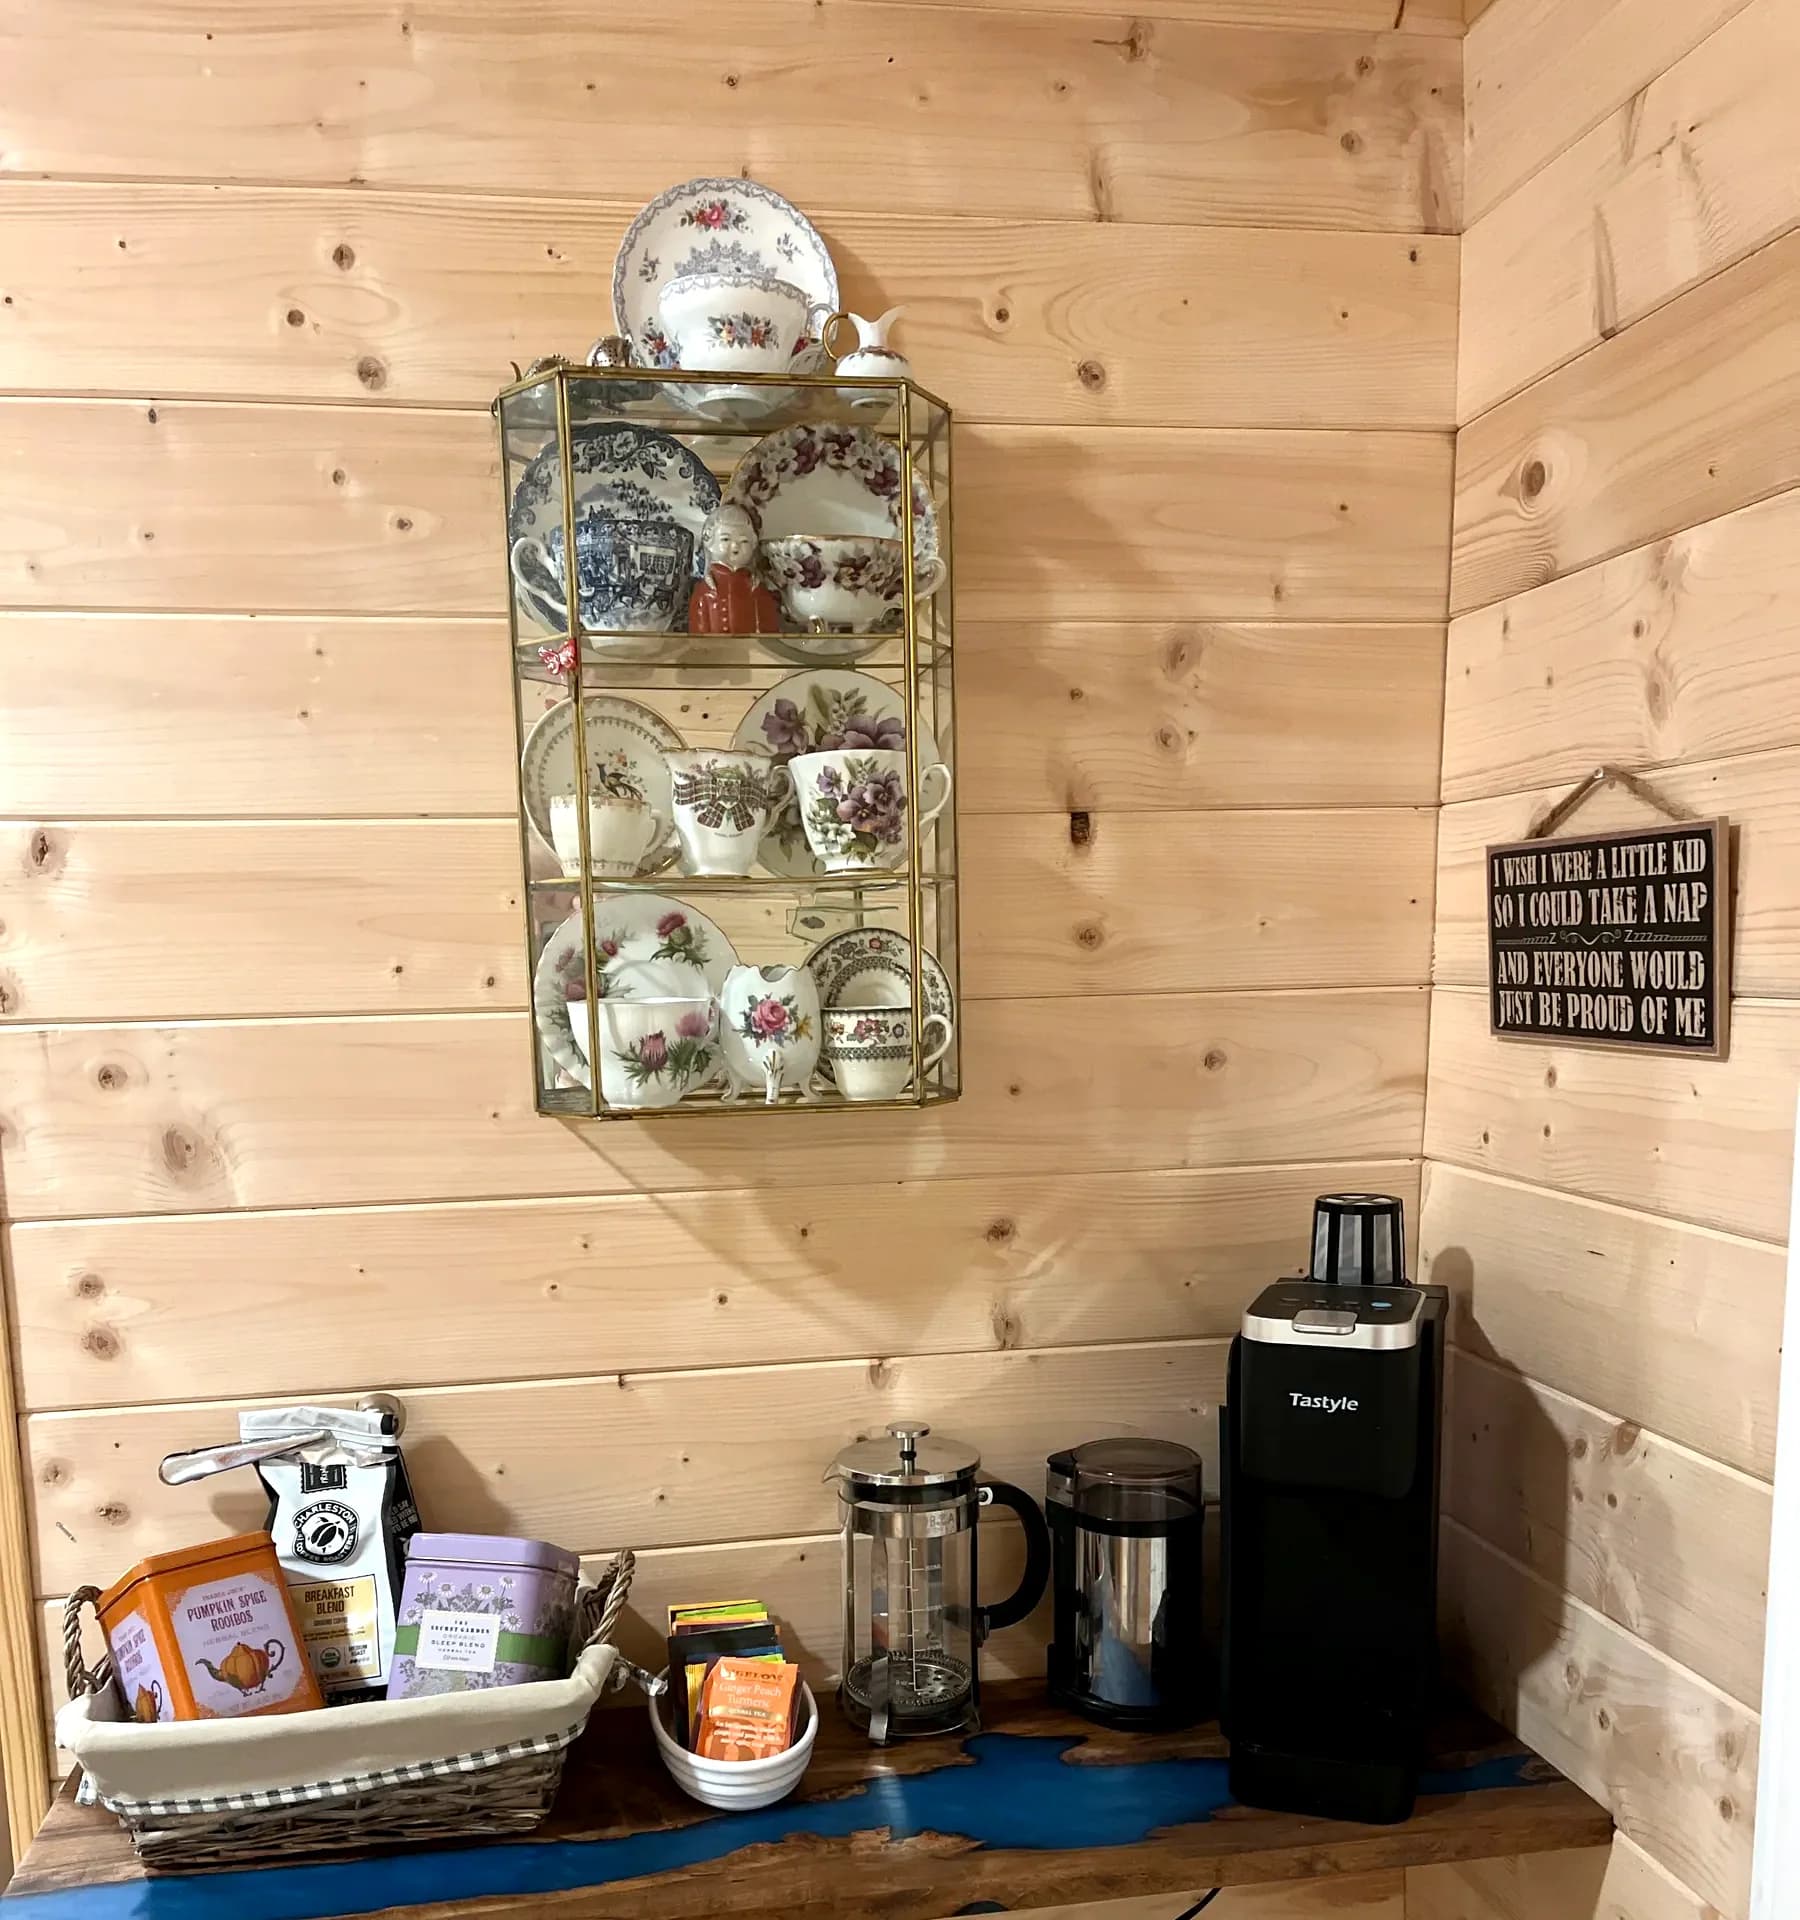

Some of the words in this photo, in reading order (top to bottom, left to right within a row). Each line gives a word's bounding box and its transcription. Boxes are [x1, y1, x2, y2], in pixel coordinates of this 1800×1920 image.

[1494, 858, 1500, 888] I
[1503, 855, 1537, 886] WISH
[1541, 854, 1547, 884] I
[1551, 849, 1592, 883] WERE
[1596, 848, 1607, 880] A
[1611, 841, 1667, 879] LITTLE
[1672, 838, 1706, 874] KID
[1494, 893, 1513, 928] SO
[1518, 893, 1525, 928] I
[1530, 889, 1583, 927] COULD
[1588, 886, 1637, 925] TAKE
[1643, 885, 1657, 924] A
[1663, 881, 1708, 924] NAP
[1498, 951, 1529, 985] AND
[1533, 951, 1624, 988] EVERYONE
[1629, 950, 1705, 990] WOULD
[1499, 990, 1533, 1027] JUST
[1539, 991, 1562, 1028] BE
[1567, 993, 1634, 1033] PROUD
[1641, 996, 1669, 1035] OF
[1675, 997, 1706, 1038] ME
[1289, 1392, 1359, 1413] Tastyle
[294, 1503, 356, 1529] CHARLESTON
[187, 1598, 236, 1622] PUMPKIN
[238, 1590, 268, 1608] SPICE
[305, 1586, 355, 1603] BREAKFAST
[316, 1600, 345, 1615] BLEND
[211, 1610, 254, 1632] ROOIBOS
